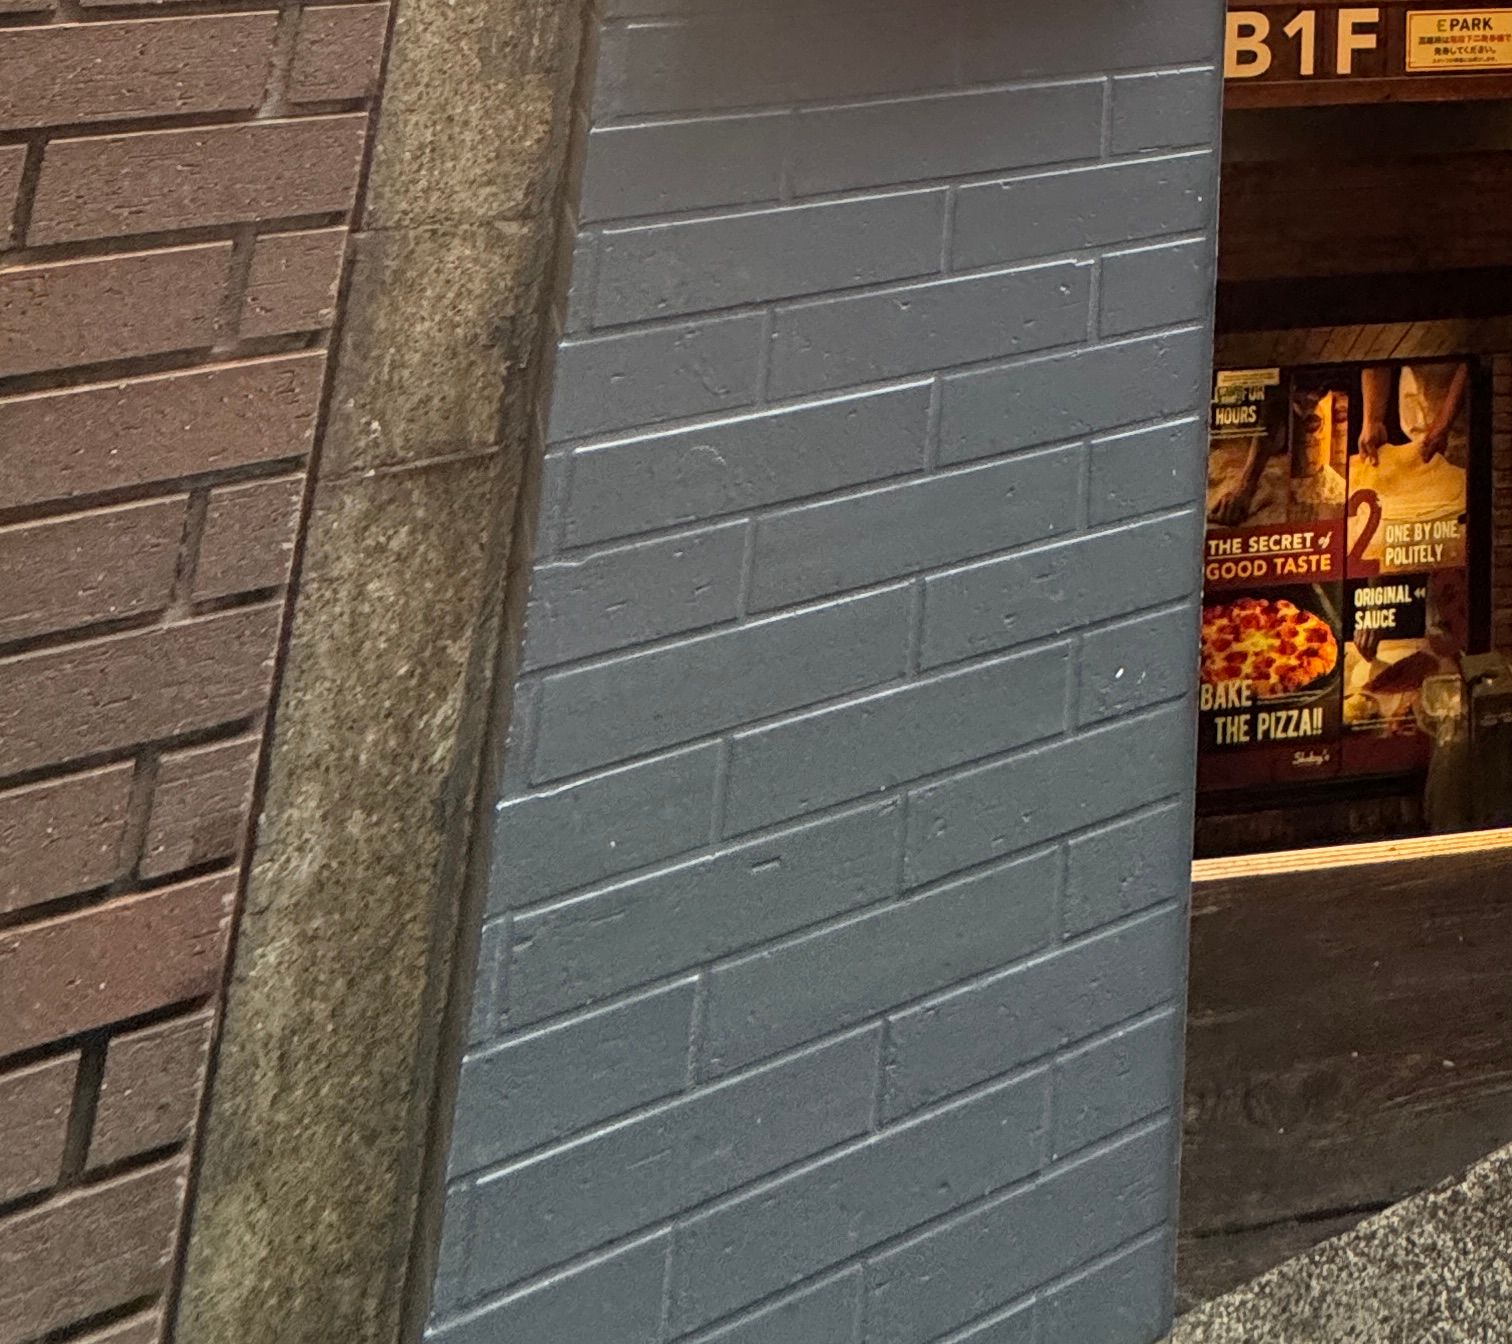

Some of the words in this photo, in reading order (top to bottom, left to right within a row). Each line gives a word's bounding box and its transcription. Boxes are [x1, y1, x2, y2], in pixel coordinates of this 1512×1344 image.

[1224, 8, 1380, 79] B1F
[1215, 405, 1257, 425] HOURS
[1208, 539, 1242, 556] THE
[1248, 532, 1315, 552] SECRET
[1318, 531, 1333, 549] of
[1347, 489, 1383, 577] 2
[1385, 525, 1410, 544] ONE
[1413, 522, 1431, 541] BY
[1206, 560, 1267, 581] GOOD
[1273, 553, 1332, 575] TASTE
[1385, 543, 1444, 566] POLITELY
[1354, 584, 1412, 608] ORIGINAL
[1354, 608, 1396, 631] SAUCE
[1200, 678, 1253, 712] BAKE
[1214, 713, 1251, 745] THE
[1257, 706, 1323, 742] PIZZA!!
